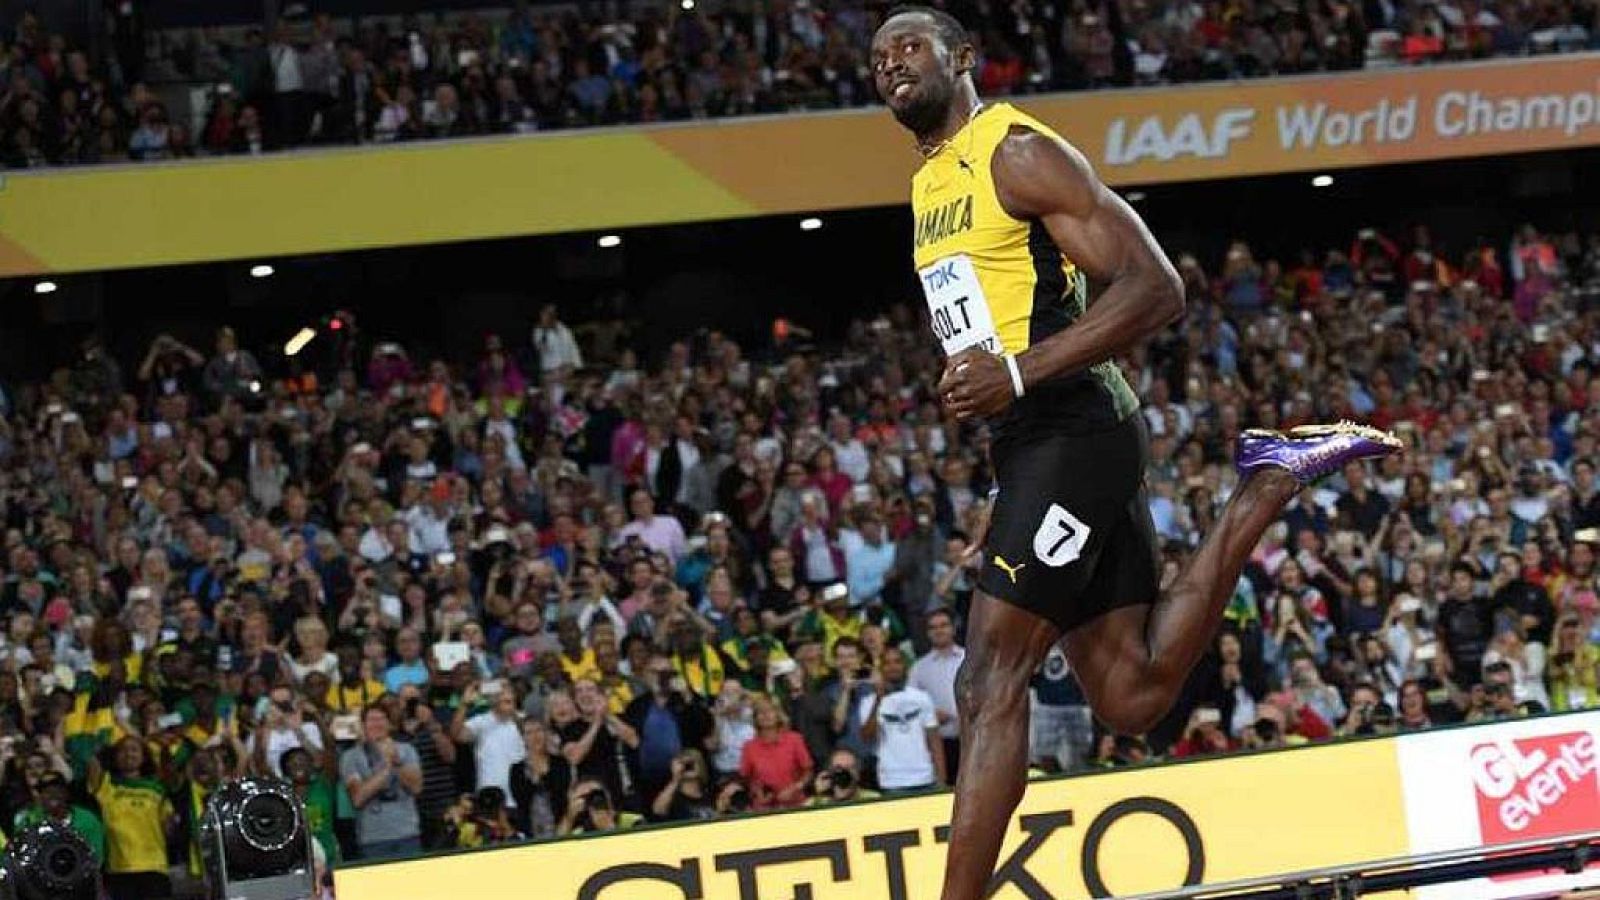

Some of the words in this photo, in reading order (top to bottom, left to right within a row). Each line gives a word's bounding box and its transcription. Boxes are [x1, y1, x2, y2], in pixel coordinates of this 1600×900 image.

[1104, 107, 1255, 165] IAAF
[1277, 96, 1417, 150] World
[916, 194, 975, 248] AMAICA
[924, 262, 960, 293] TDK
[932, 295, 971, 340] OLT
[1047, 517, 1076, 557] 7
[1470, 738, 1548, 799] GL
[1500, 733, 1600, 831] events
